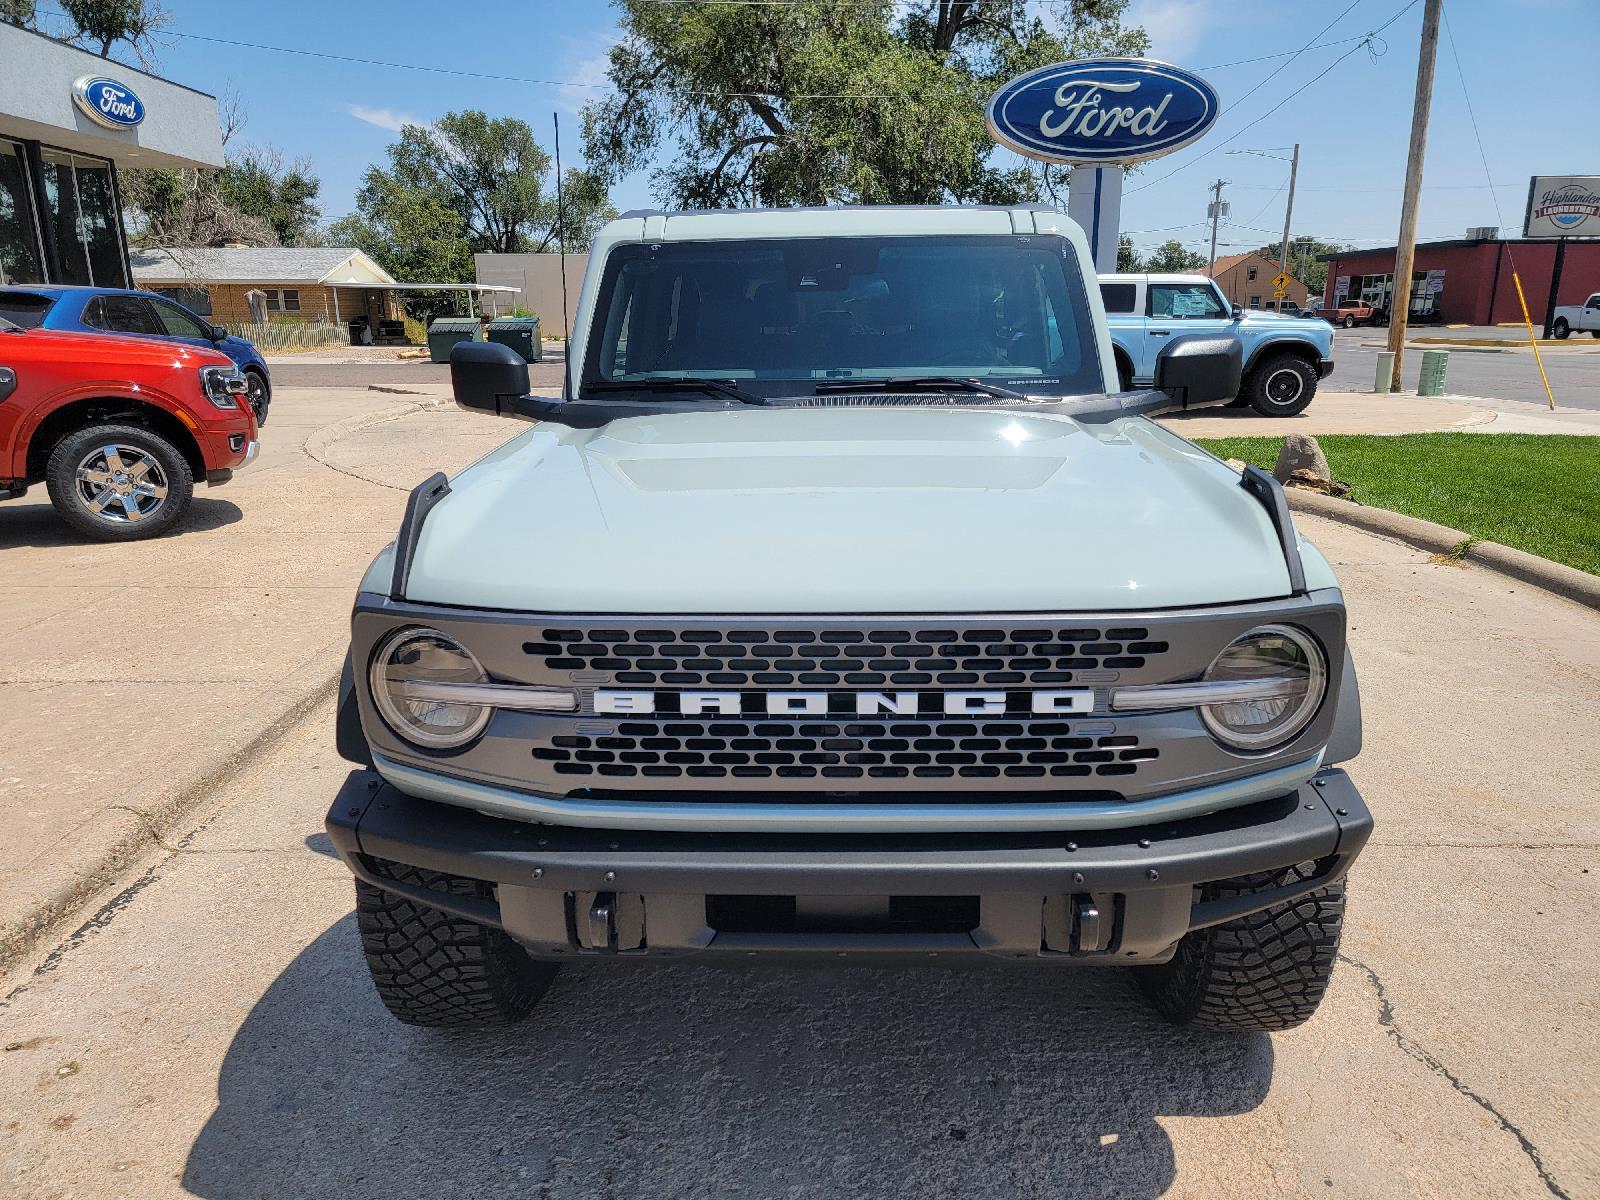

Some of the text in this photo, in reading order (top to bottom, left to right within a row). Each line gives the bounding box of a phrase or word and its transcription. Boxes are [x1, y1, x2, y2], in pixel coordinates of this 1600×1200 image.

[100, 87, 137, 119] Ford
[1039, 80, 1173, 138] Ford
[593, 690, 1095, 715] BRONCO
